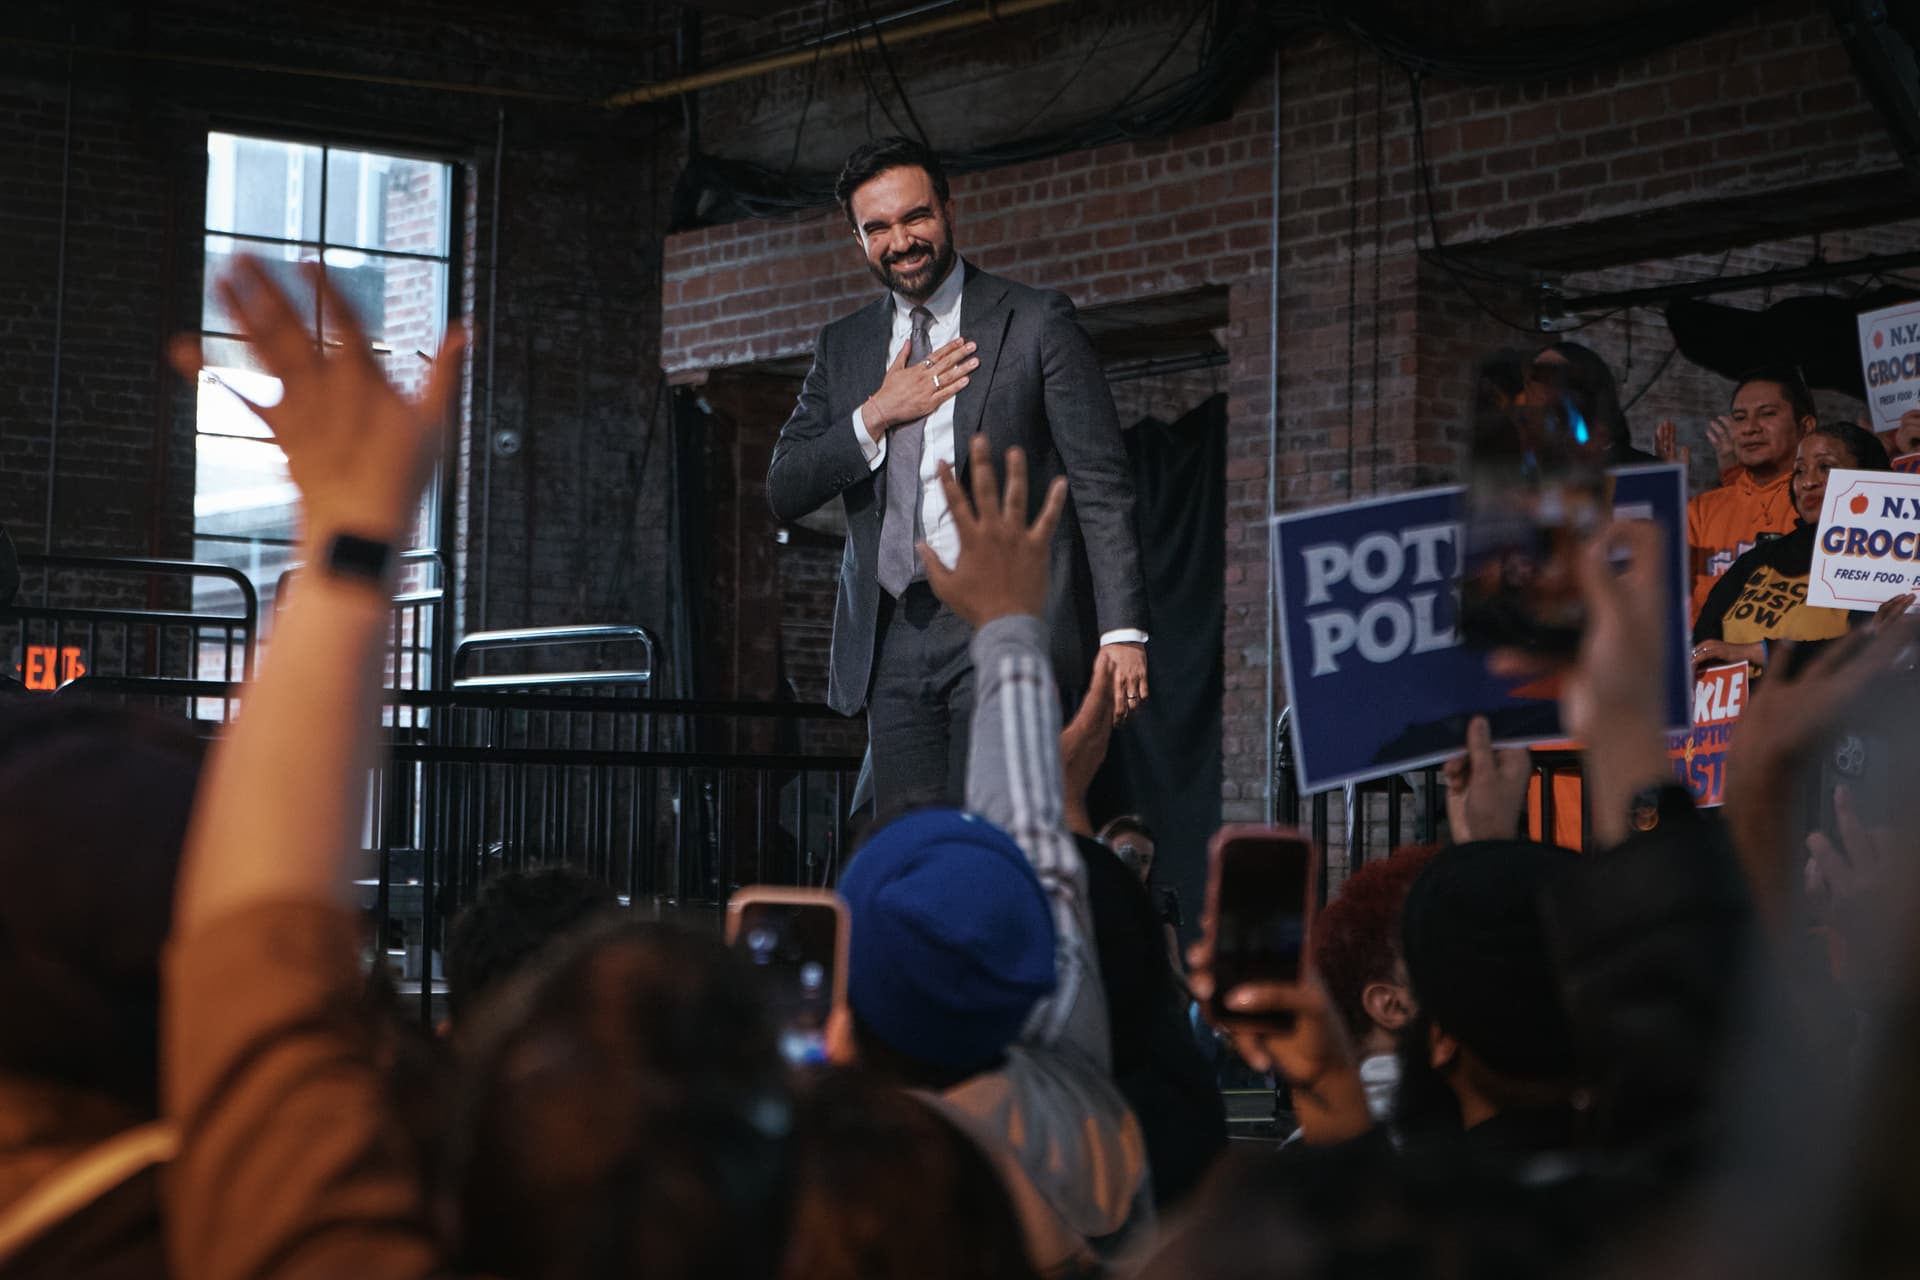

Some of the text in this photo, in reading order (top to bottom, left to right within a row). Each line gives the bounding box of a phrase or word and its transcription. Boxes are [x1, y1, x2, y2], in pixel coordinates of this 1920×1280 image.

[1301, 523, 1464, 606] POT
[1834, 569, 1871, 581] FRESH
[1873, 572, 1905, 584] FOOD
[1305, 591, 1464, 677] POL
[25, 645, 81, 690] EXIT
[1693, 671, 1744, 724] KLE
